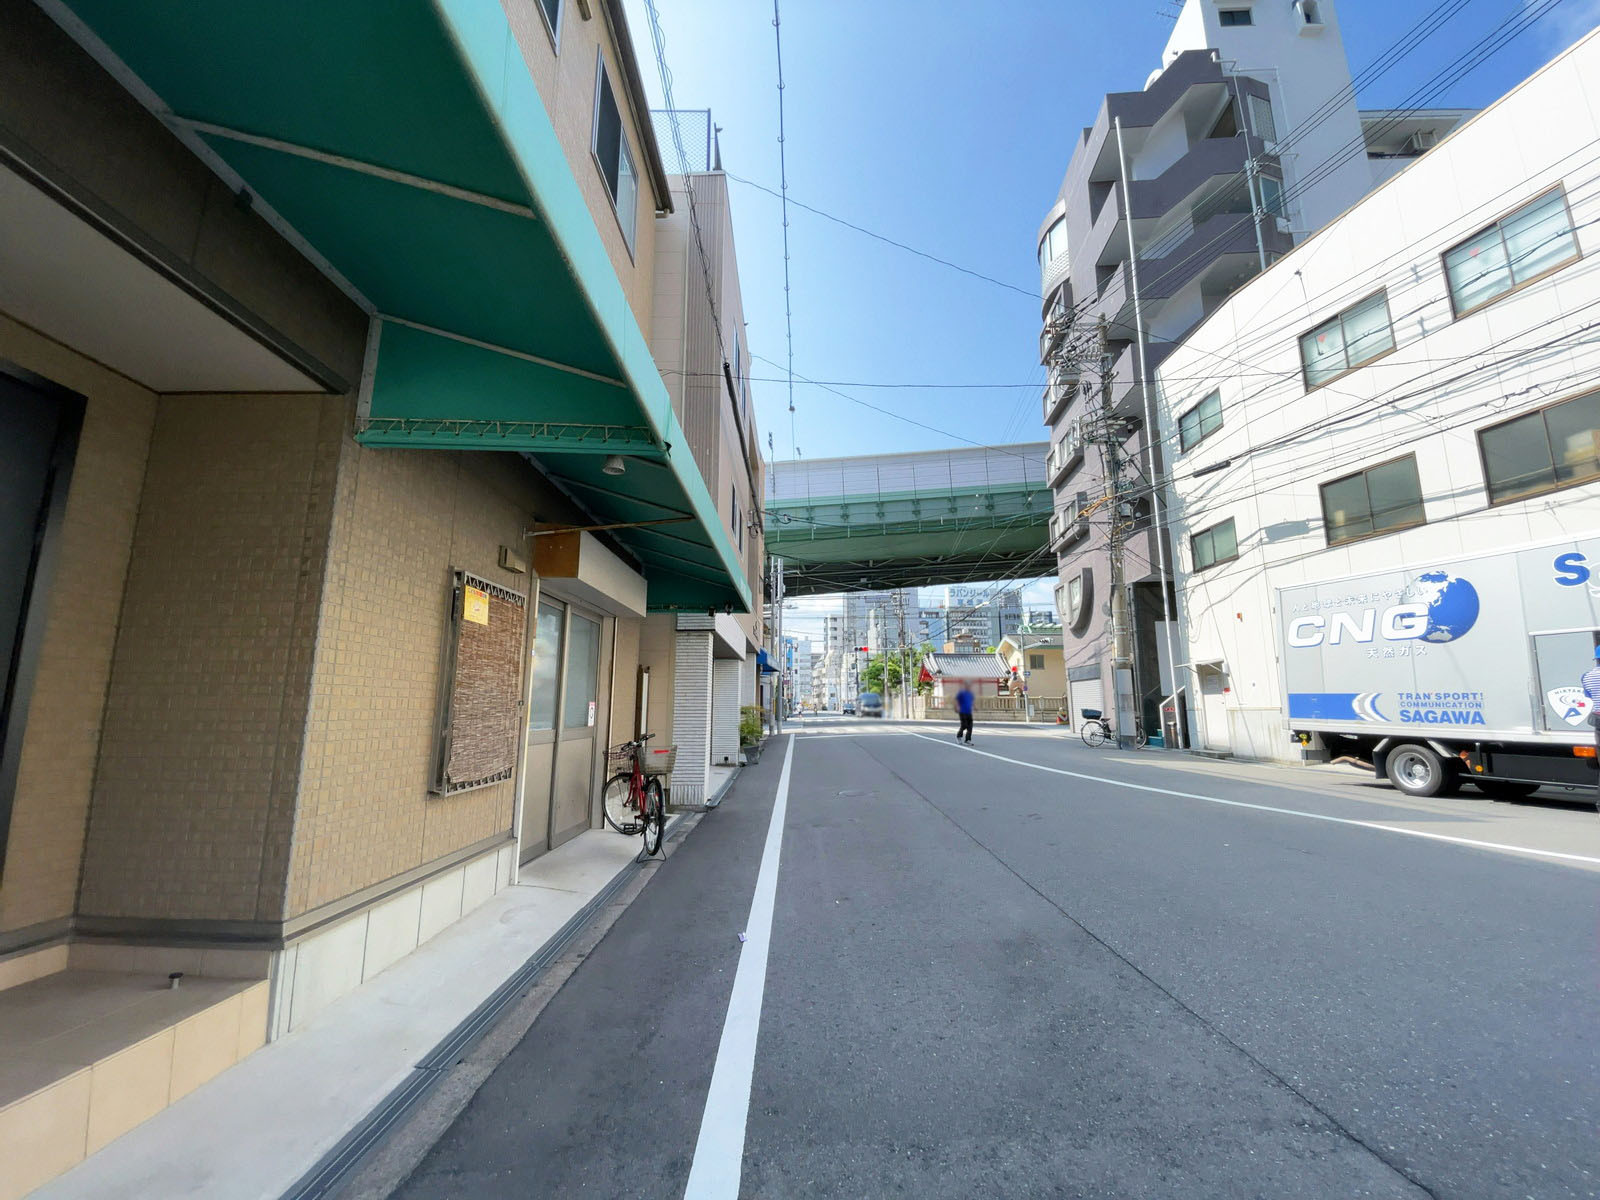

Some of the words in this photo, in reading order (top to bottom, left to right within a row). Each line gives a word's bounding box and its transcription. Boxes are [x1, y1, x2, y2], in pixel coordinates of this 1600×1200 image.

[1287, 602, 1429, 648] CNG
[1367, 645, 1427, 659] 天然ガス
[1400, 701, 1482, 709] COMMUNICATION
[1400, 709, 1486, 725] SAGAWA
